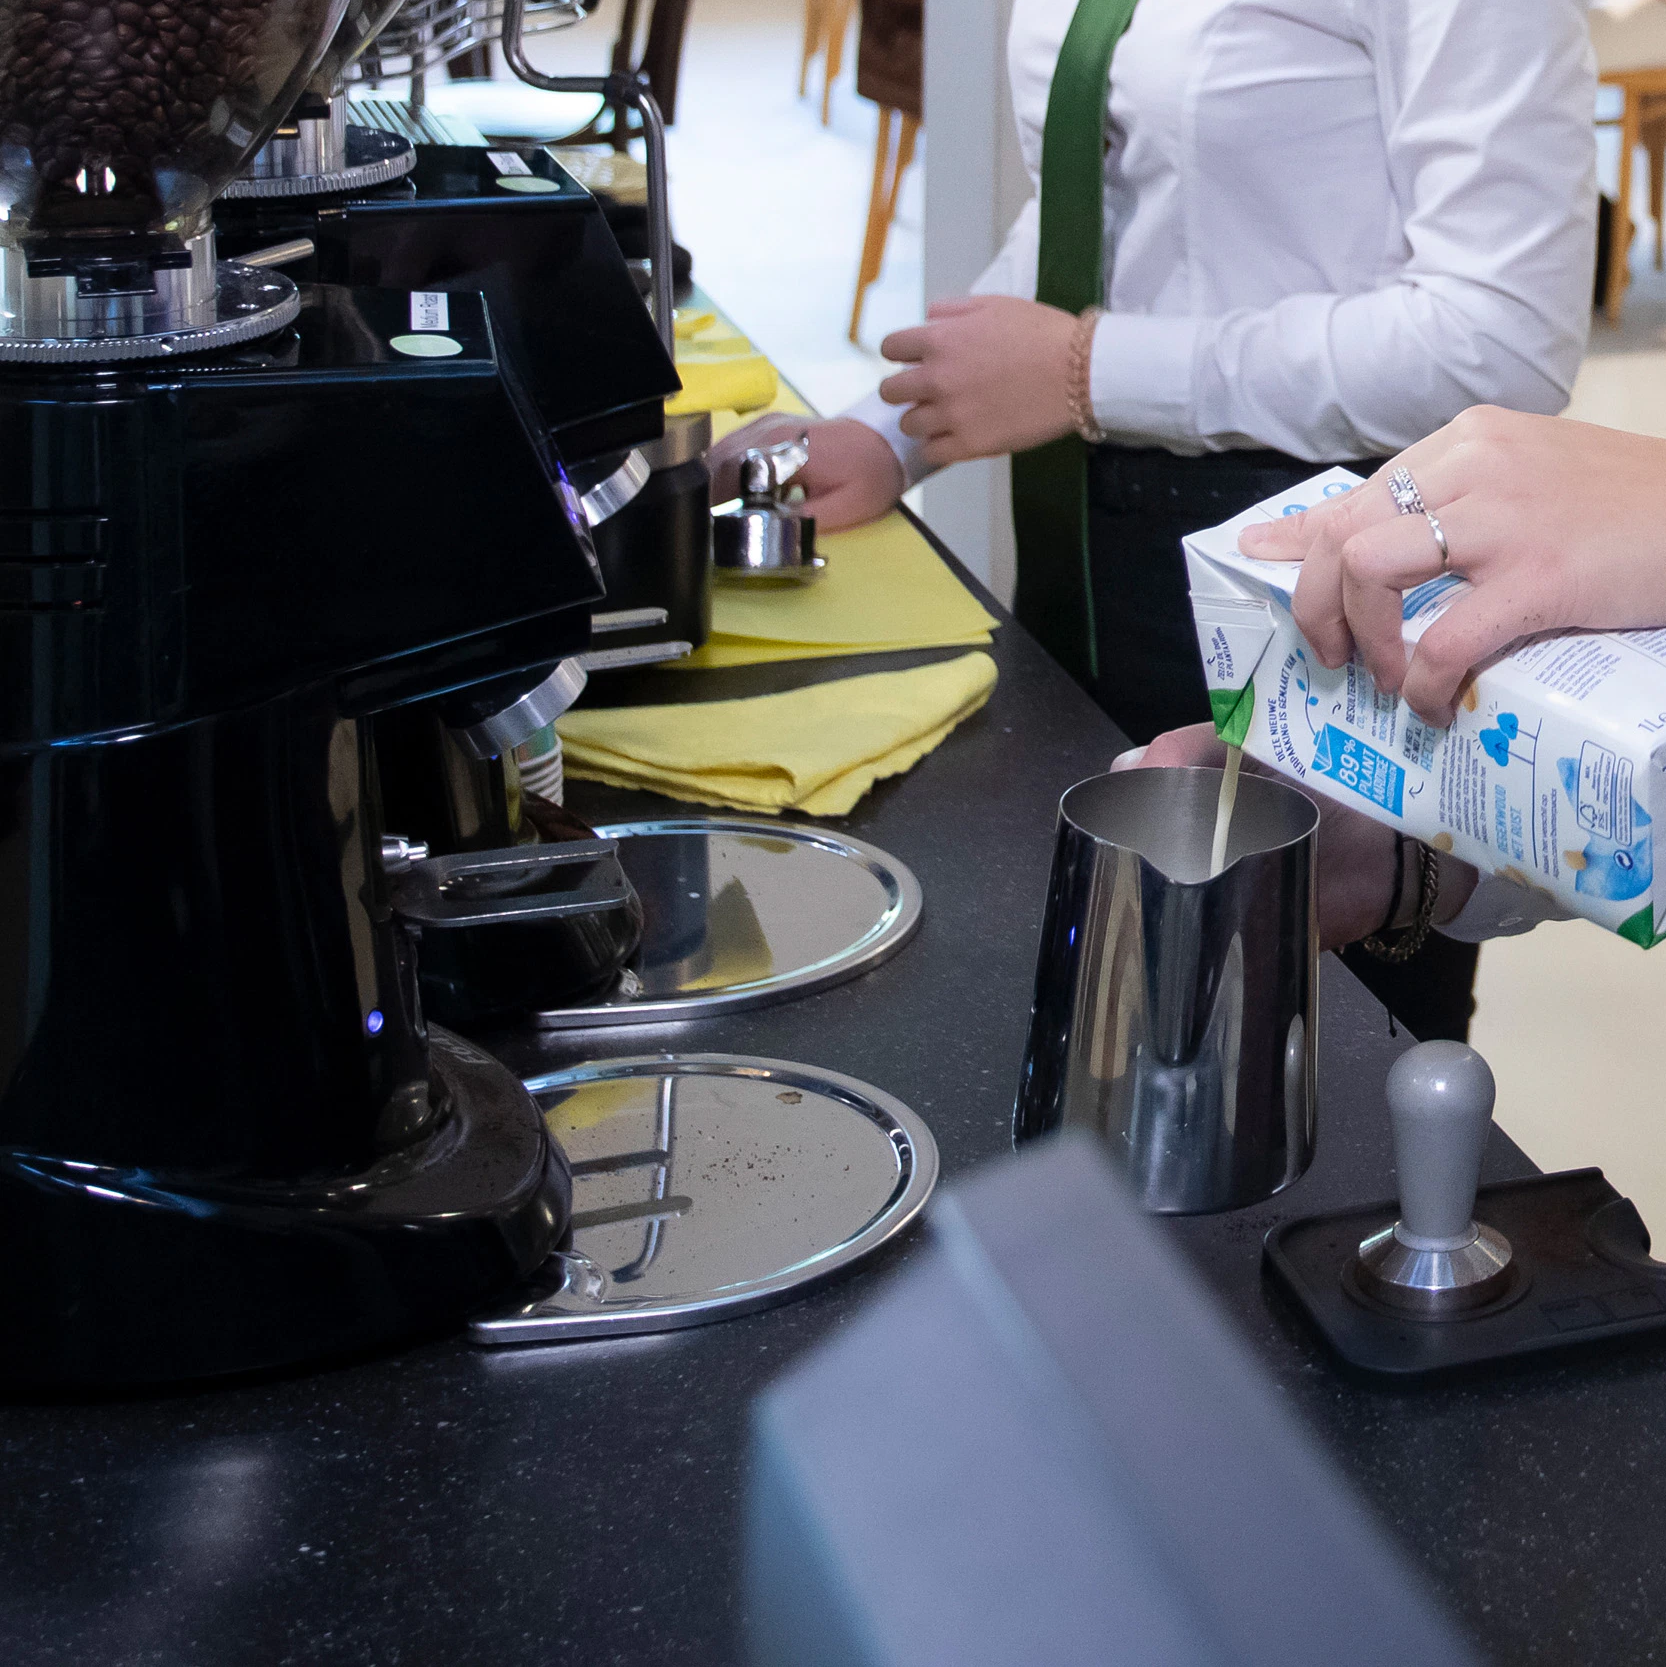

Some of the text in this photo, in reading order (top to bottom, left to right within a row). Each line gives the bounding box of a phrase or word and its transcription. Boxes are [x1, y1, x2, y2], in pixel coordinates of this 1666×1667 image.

[1216, 651, 1224, 659] DE
[1216, 660, 1224, 680] ZELFS
[1226, 670, 1234, 678] IS
[1268, 698, 1285, 762] DEZE NIEUWE
[1278, 655, 1306, 778] VERPAKKING IS GEMAAKT VAN
[1358, 746, 1376, 796] PLANT
[1371, 754, 1389, 805] AARDIGE
[1495, 783, 1508, 854] REGENWOUD
[1511, 837, 1524, 862] MET
